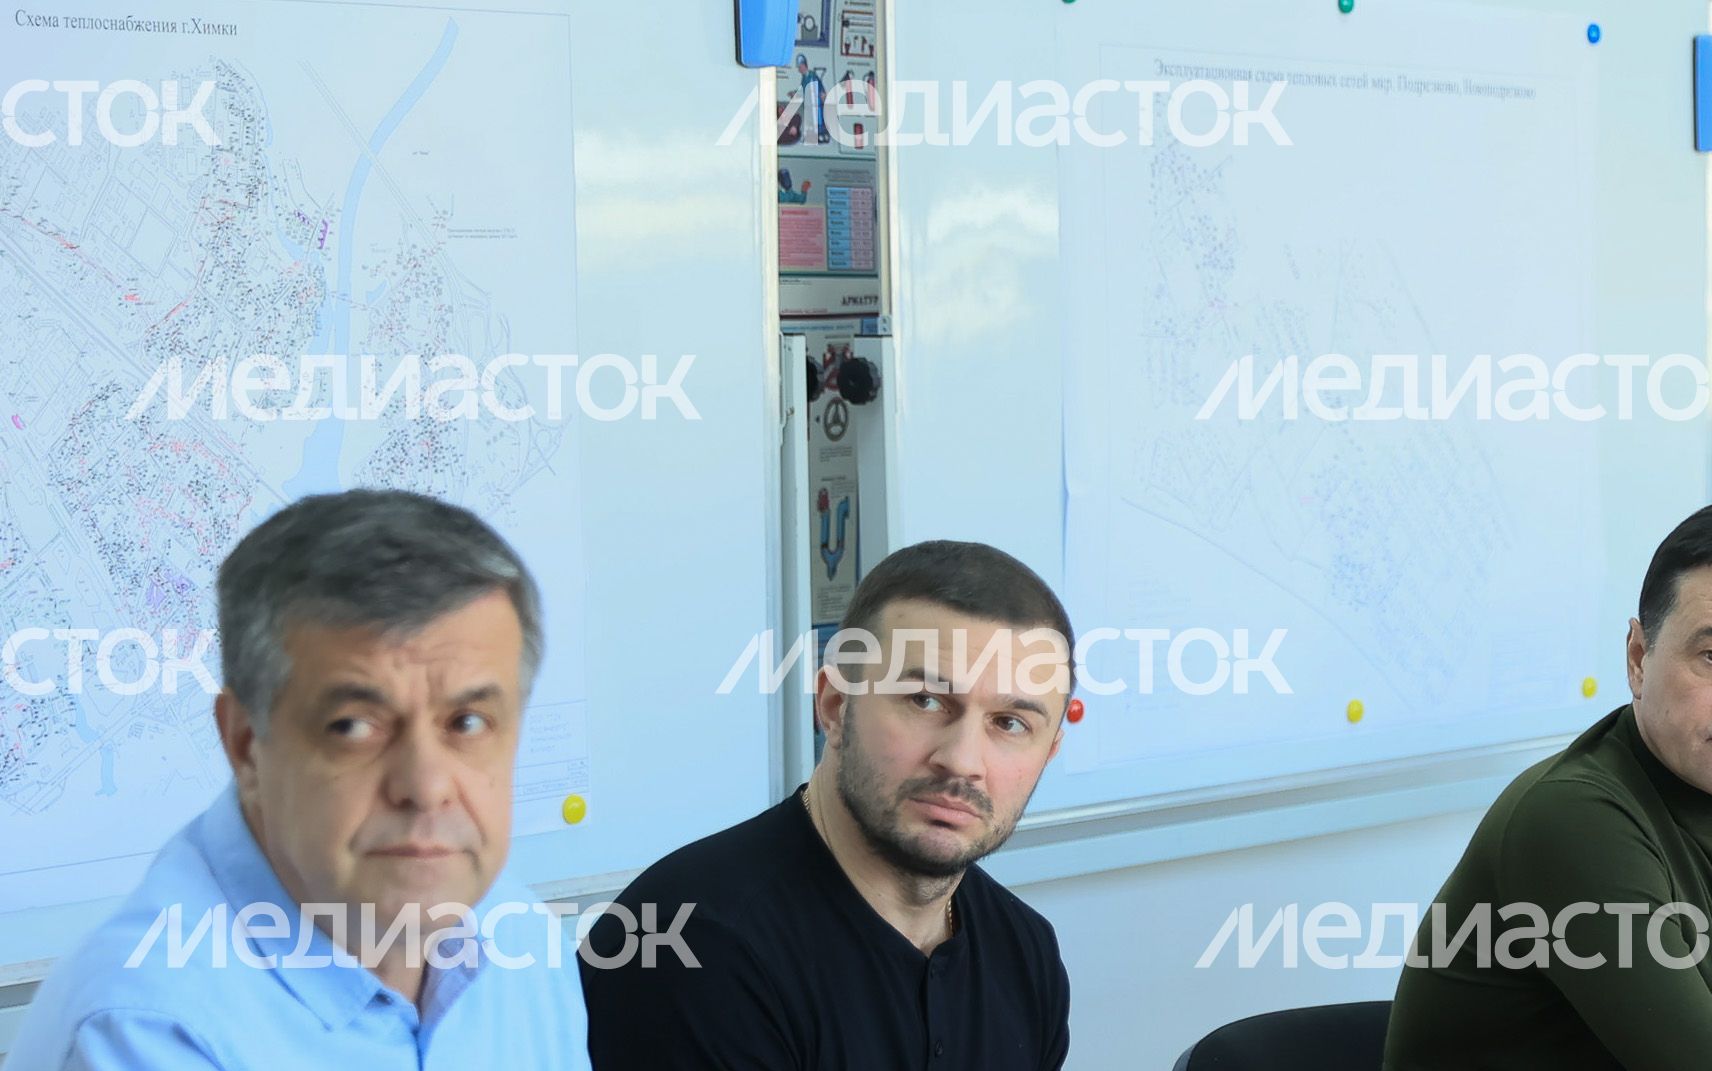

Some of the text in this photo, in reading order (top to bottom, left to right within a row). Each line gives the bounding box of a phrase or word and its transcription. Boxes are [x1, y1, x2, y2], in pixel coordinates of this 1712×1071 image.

[14, 8, 238, 37] Схема теплоснабжения г.Химки
